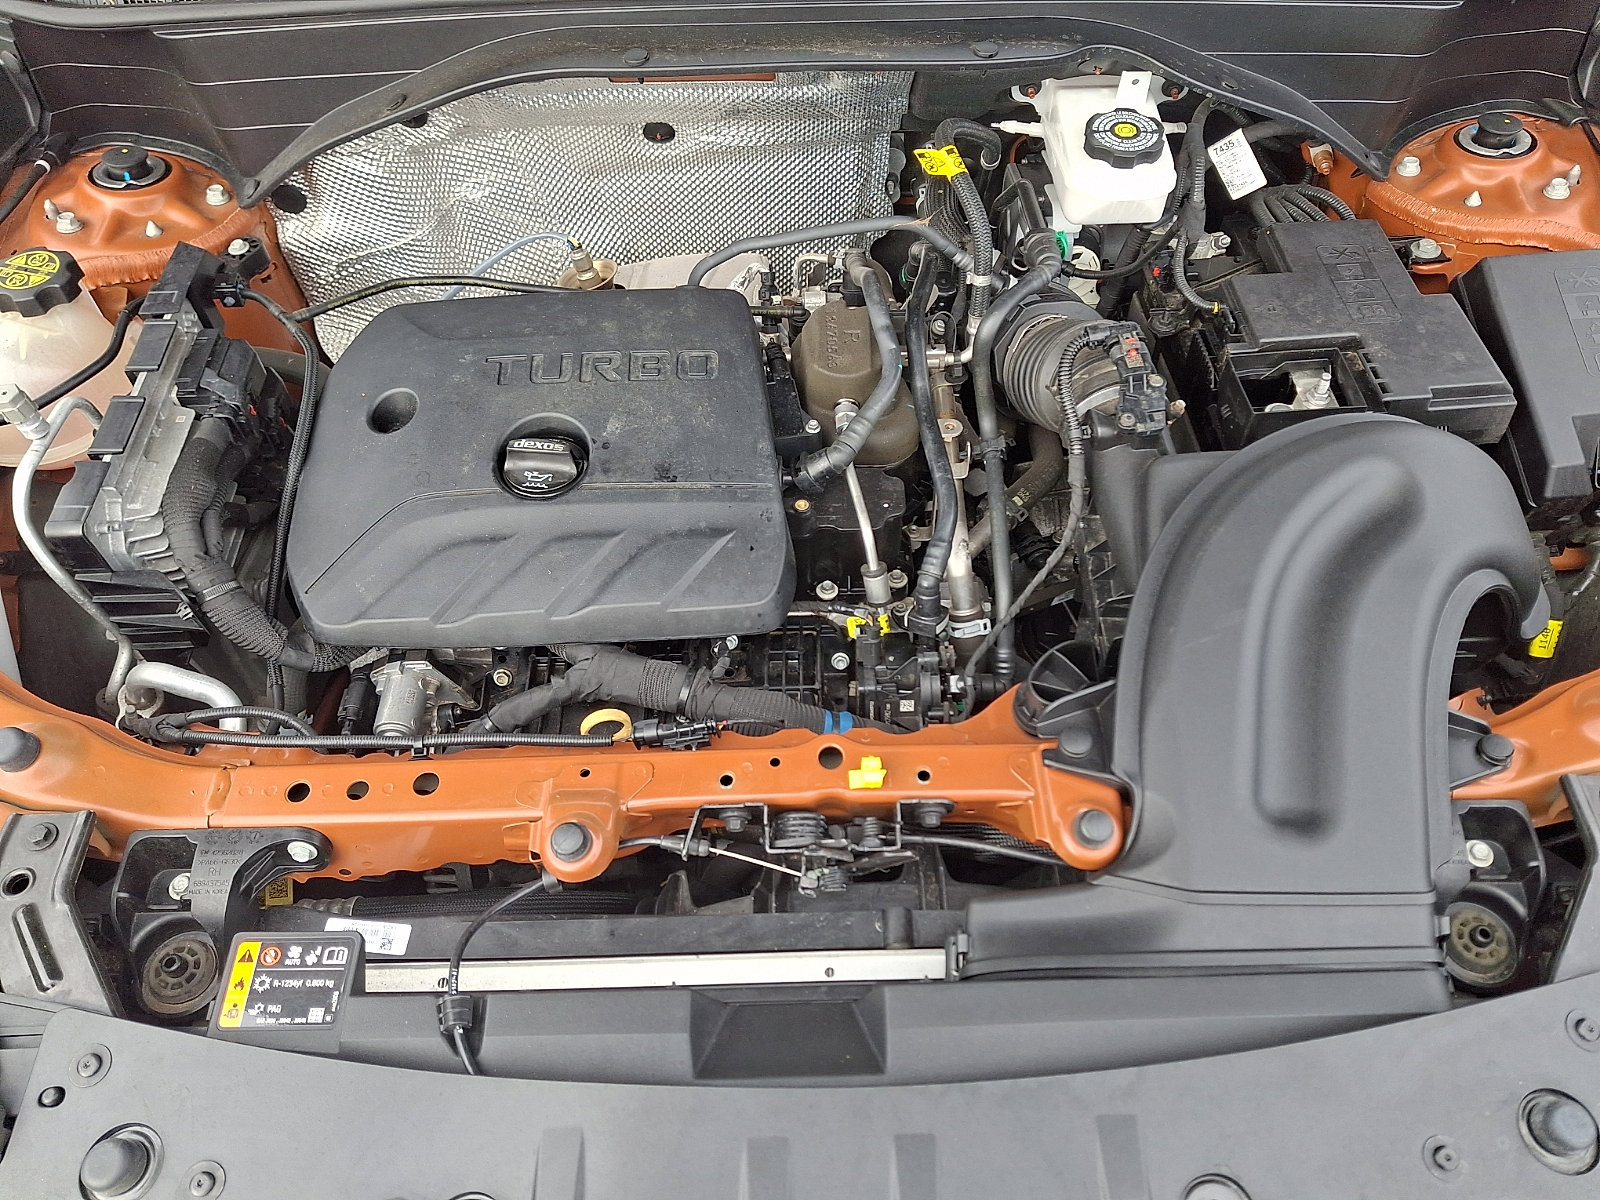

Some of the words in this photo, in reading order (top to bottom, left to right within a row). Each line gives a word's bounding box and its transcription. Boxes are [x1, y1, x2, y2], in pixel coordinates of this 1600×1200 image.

[1213, 139, 1236, 156] 7435
[485, 350, 720, 386] TURBO
[513, 439, 566, 452] dexos
[208, 867, 222, 877] RH
[284, 958, 301, 966] AUTO
[272, 979, 304, 989] R-1234yf
[325, 979, 335, 989] kg
[267, 1004, 282, 1014] PAG
